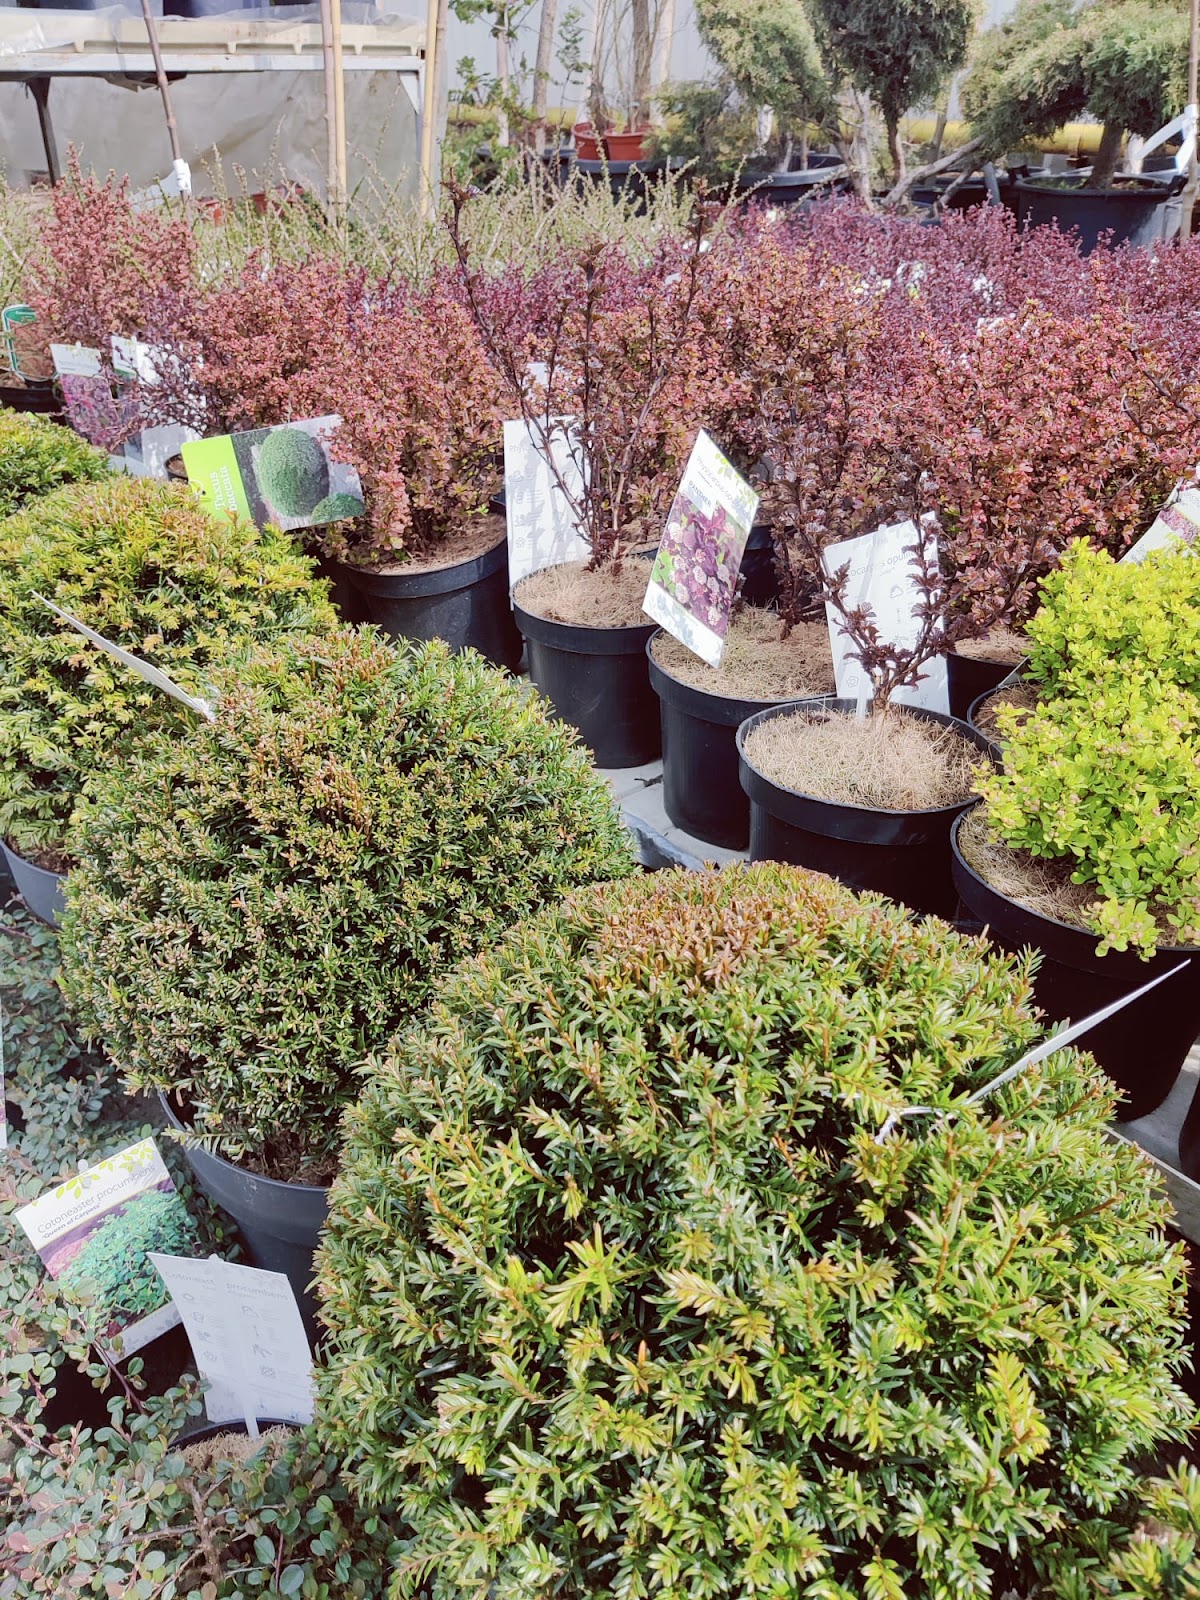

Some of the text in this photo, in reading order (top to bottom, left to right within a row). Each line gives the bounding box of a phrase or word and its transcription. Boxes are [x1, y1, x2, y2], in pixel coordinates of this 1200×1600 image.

[210, 472, 225, 510] Taxus
[688, 480, 712, 506] PANTHER
[38, 1165, 155, 1233] Cotoneaster procumbens
[66, 1217, 74, 1226] of
